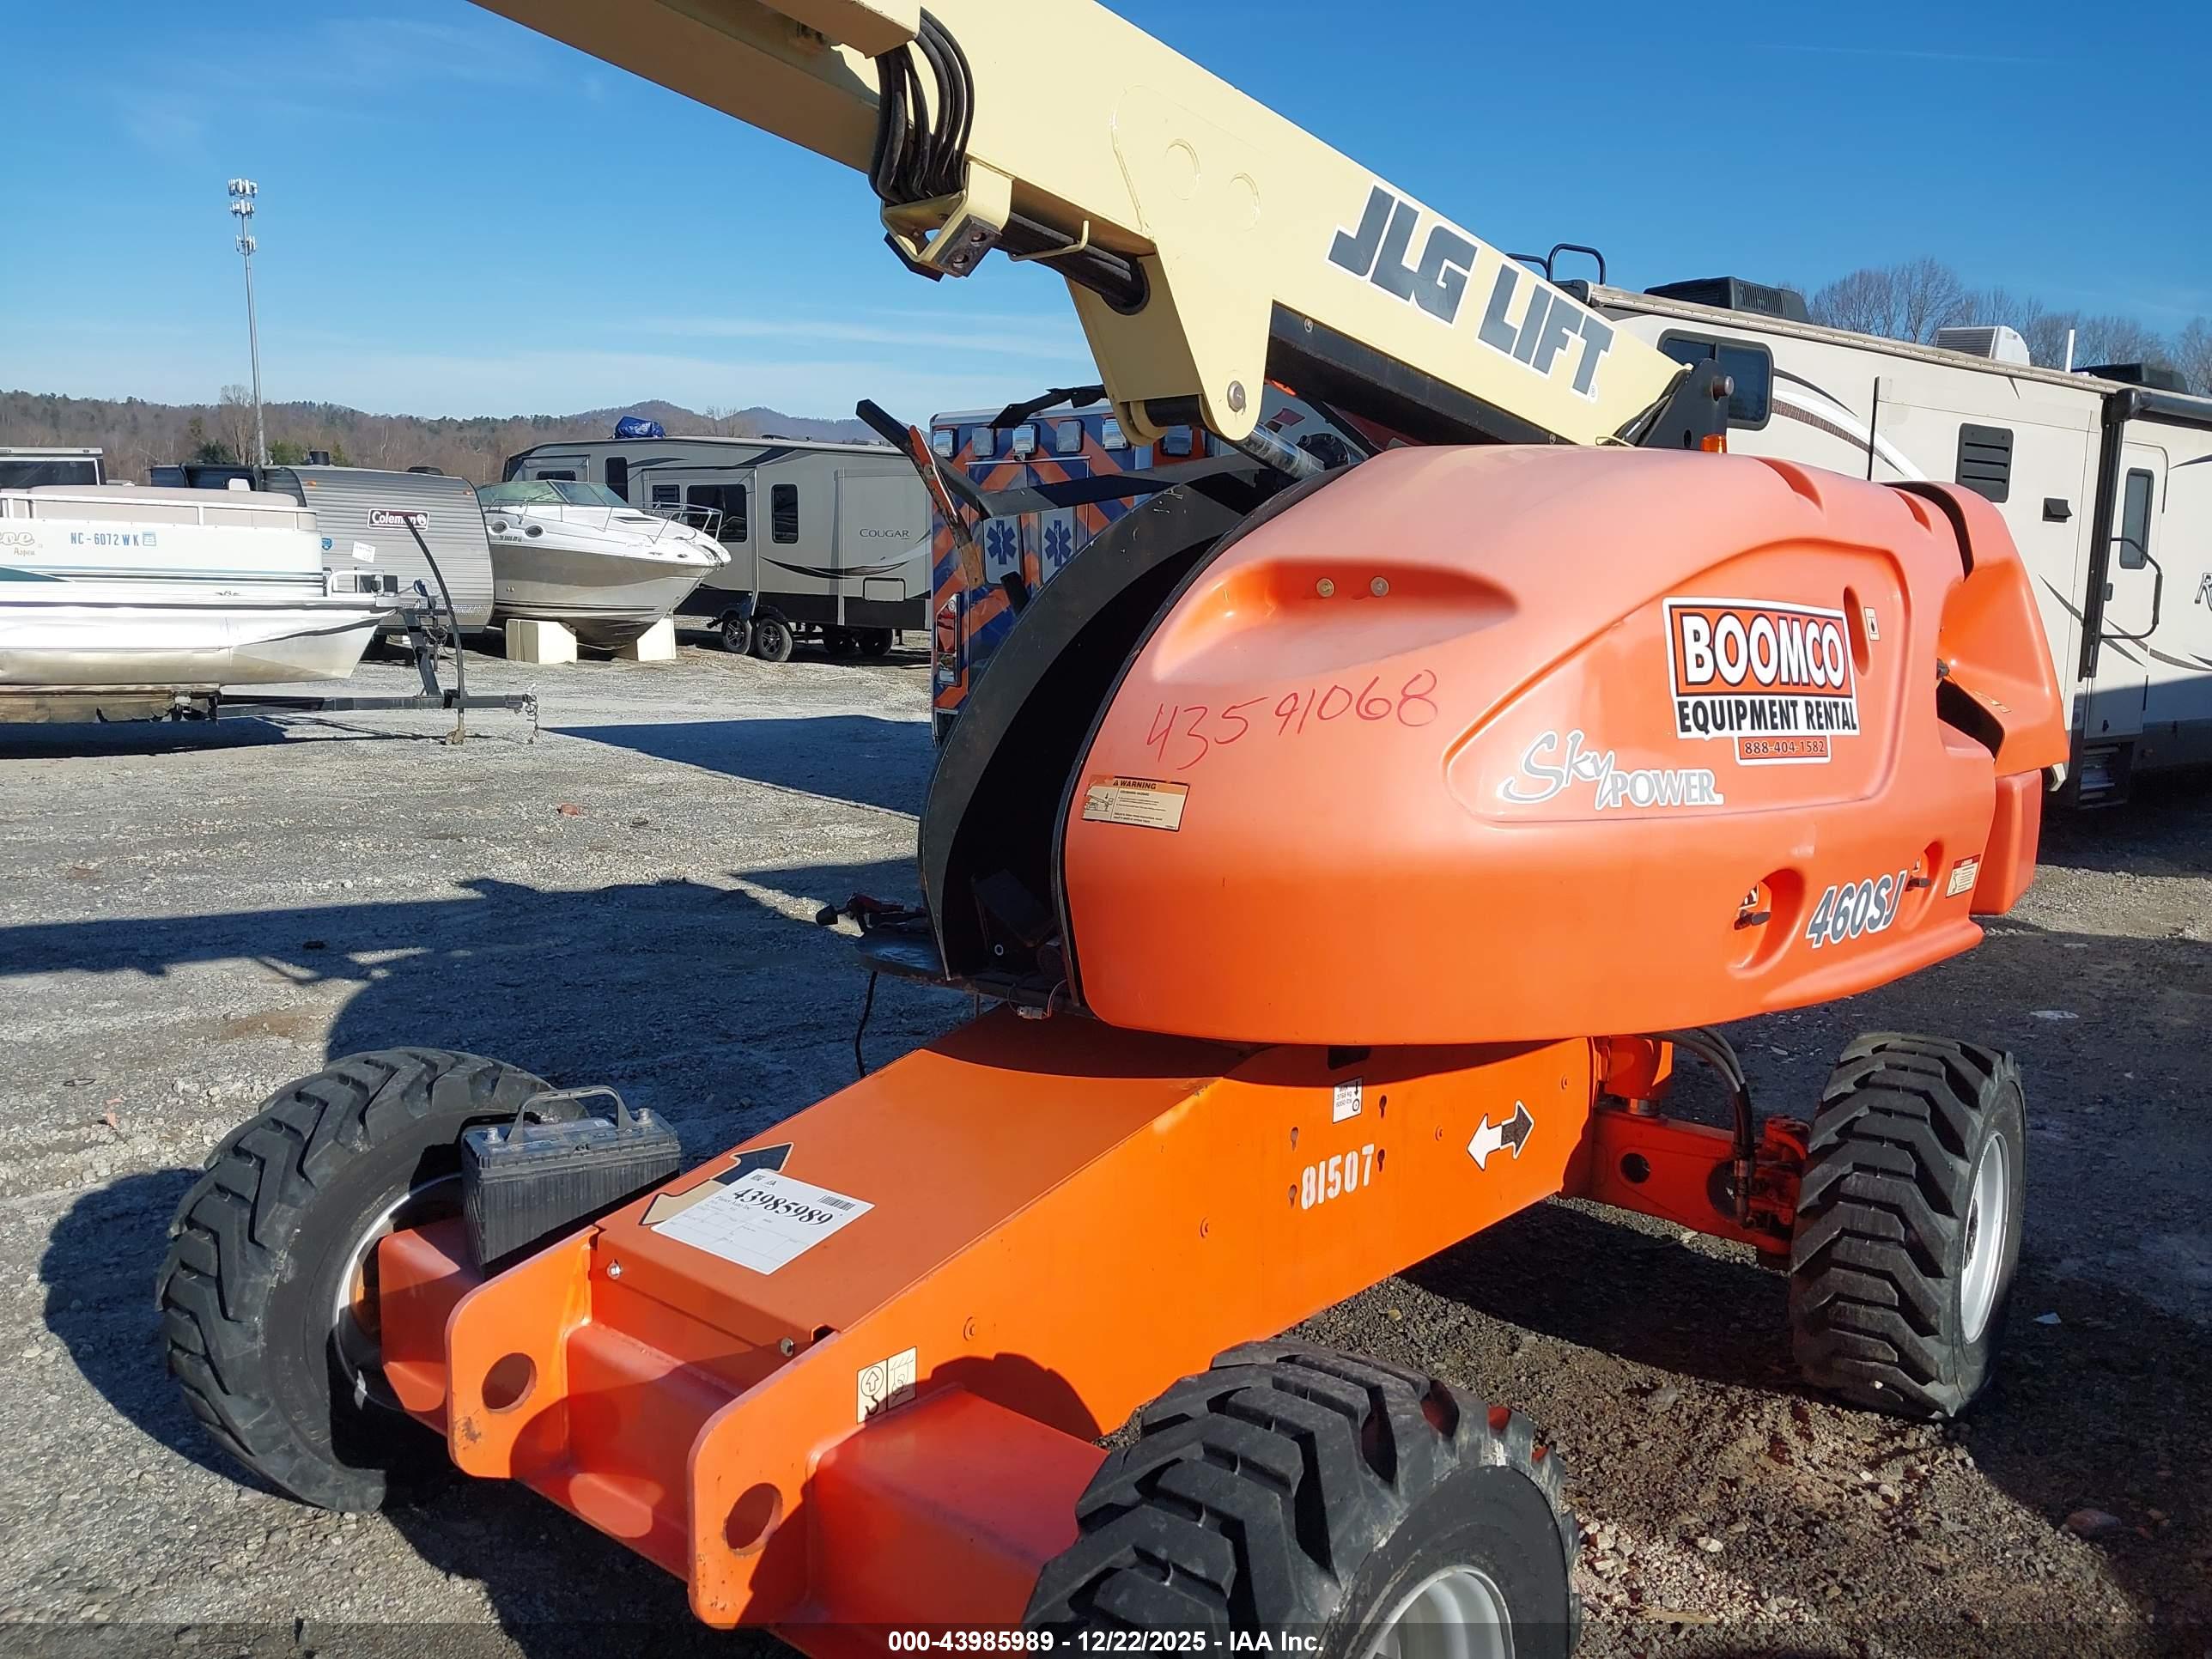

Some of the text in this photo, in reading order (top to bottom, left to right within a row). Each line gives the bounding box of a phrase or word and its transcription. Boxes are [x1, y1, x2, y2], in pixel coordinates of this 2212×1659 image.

[1327, 182, 1616, 397] JLG LIFT
[371, 511, 416, 526] Colemn
[860, 528, 910, 538] COUGAR
[1680, 611, 1845, 690] BOOMCO
[1677, 699, 1858, 735] EQUIPMENT RENTAL
[1744, 740, 1826, 755] 888-404-1582
[1120, 779, 1158, 790] WARNING
[1807, 870, 1907, 946] 460SJ
[1300, 1143, 1374, 1211] 81507
[732, 1188, 835, 1226] 43985989
